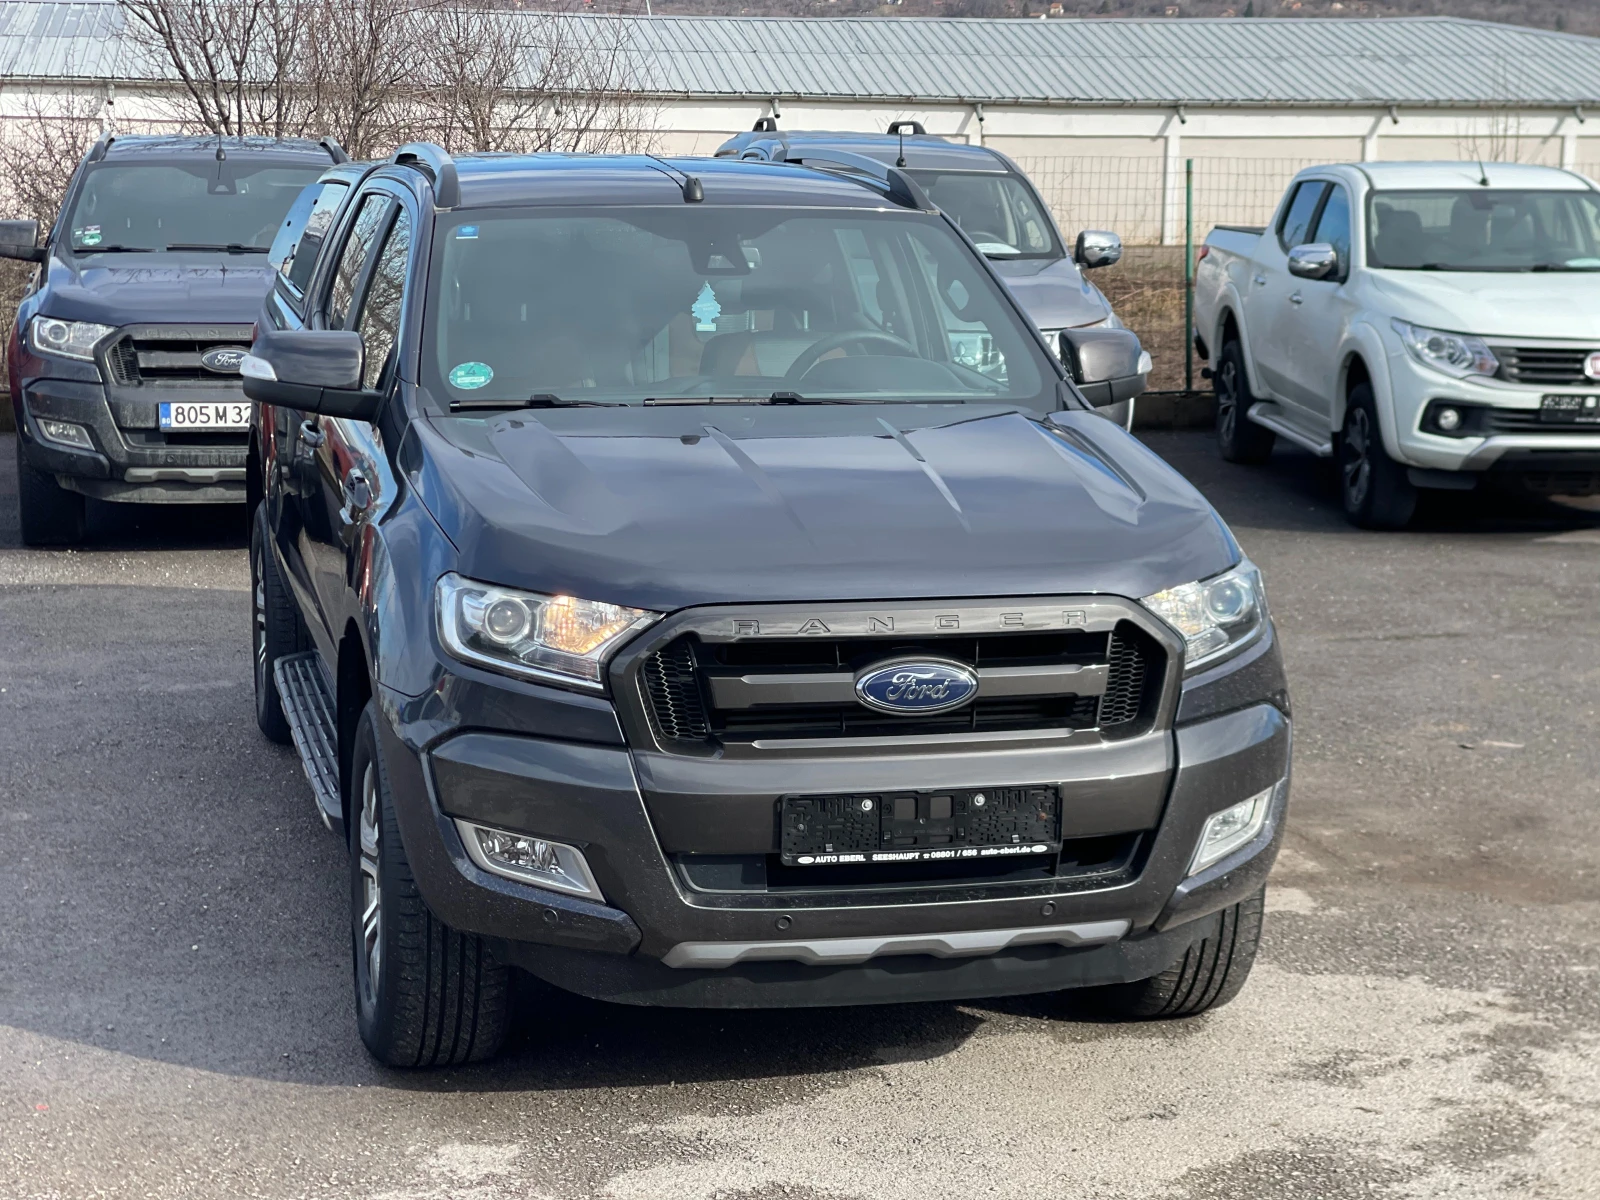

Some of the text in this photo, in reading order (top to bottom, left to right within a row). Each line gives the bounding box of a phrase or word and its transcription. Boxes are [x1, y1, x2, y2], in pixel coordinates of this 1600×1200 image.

[732, 610, 1087, 635] RANGER
[886, 672, 951, 700] Ford
[815, 855, 838, 863] AUTO
[839, 854, 866, 862] EBERL
[872, 852, 920, 861] SEESHAUPT
[930, 850, 955, 858] 08801
[980, 846, 1031, 855] auto-eberl.de
